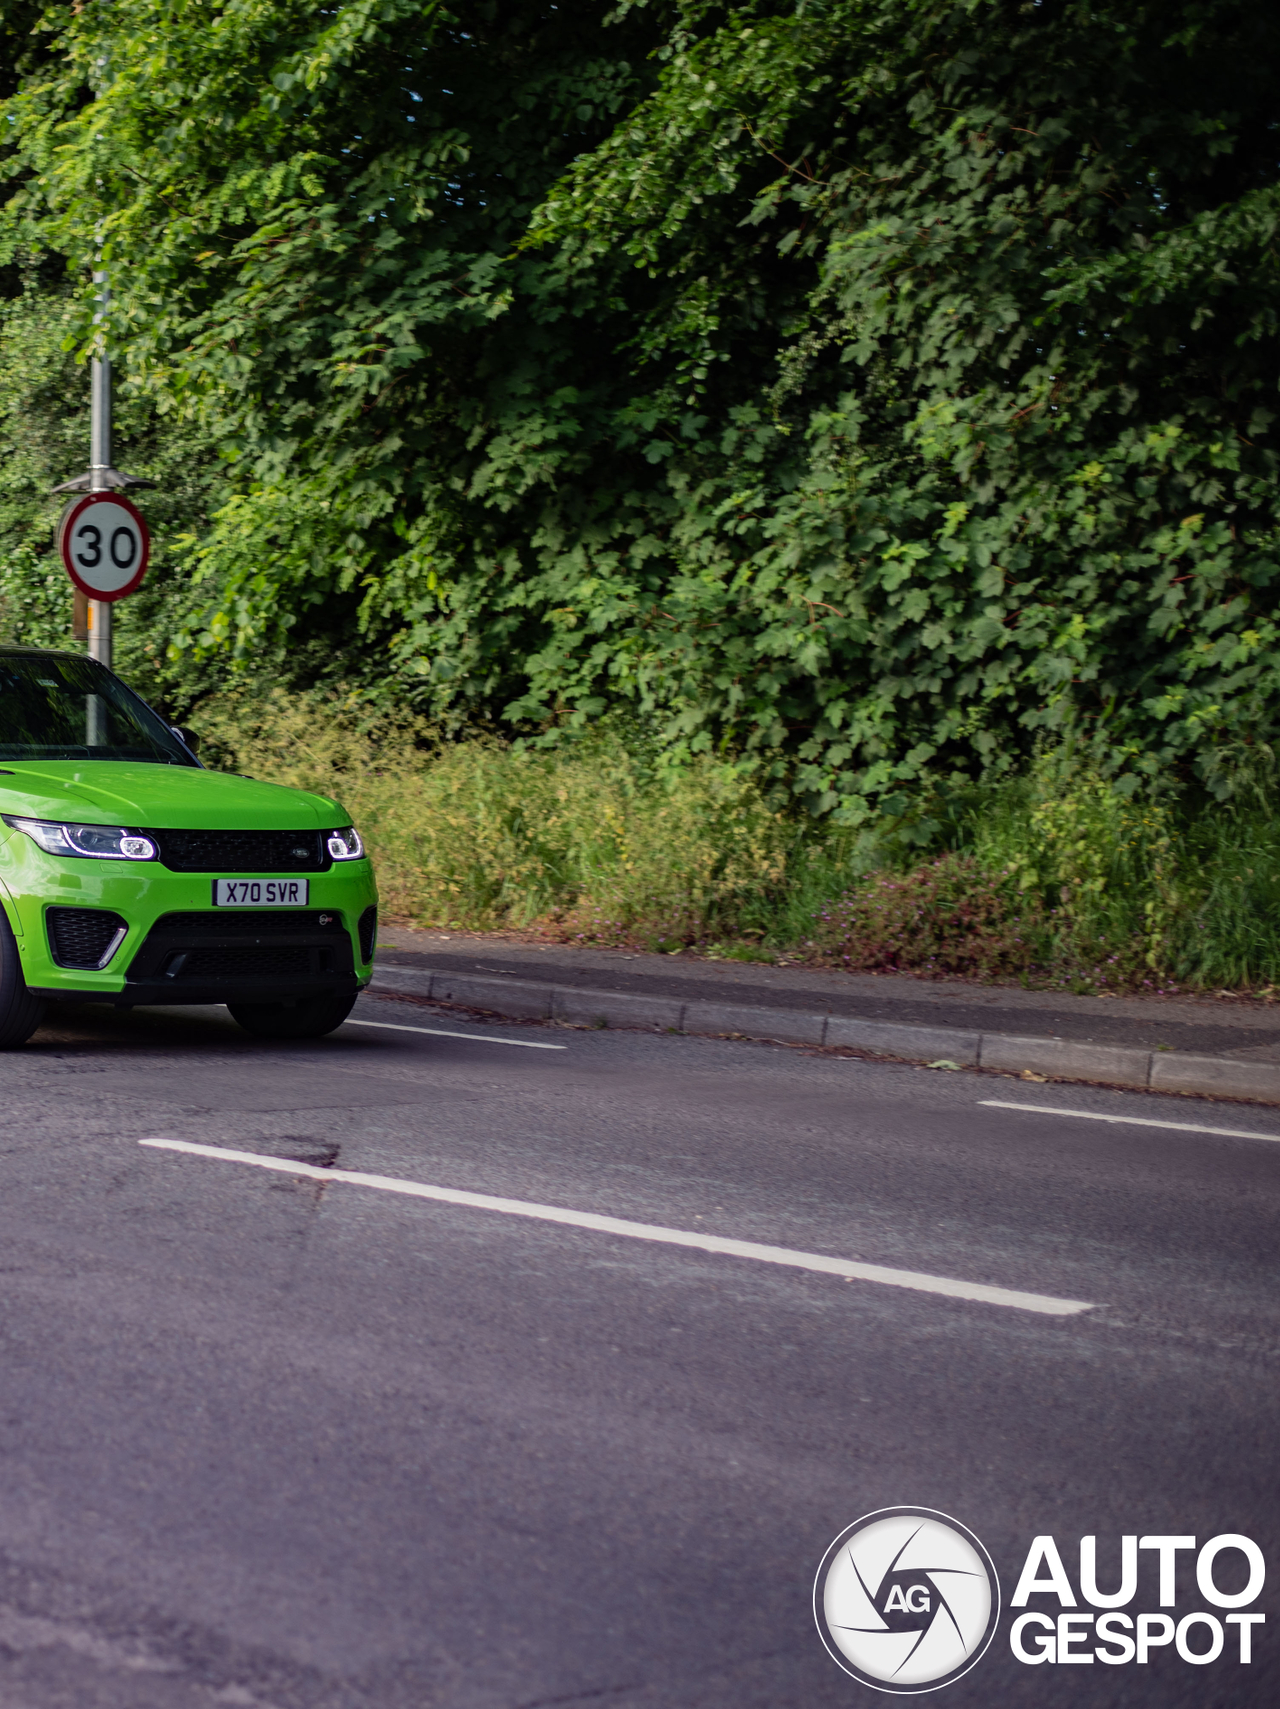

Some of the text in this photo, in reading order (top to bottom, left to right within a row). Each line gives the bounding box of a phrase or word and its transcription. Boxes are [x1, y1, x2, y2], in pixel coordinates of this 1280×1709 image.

[77, 525, 136, 569] 30
[226, 883, 299, 902] X70 SVR
